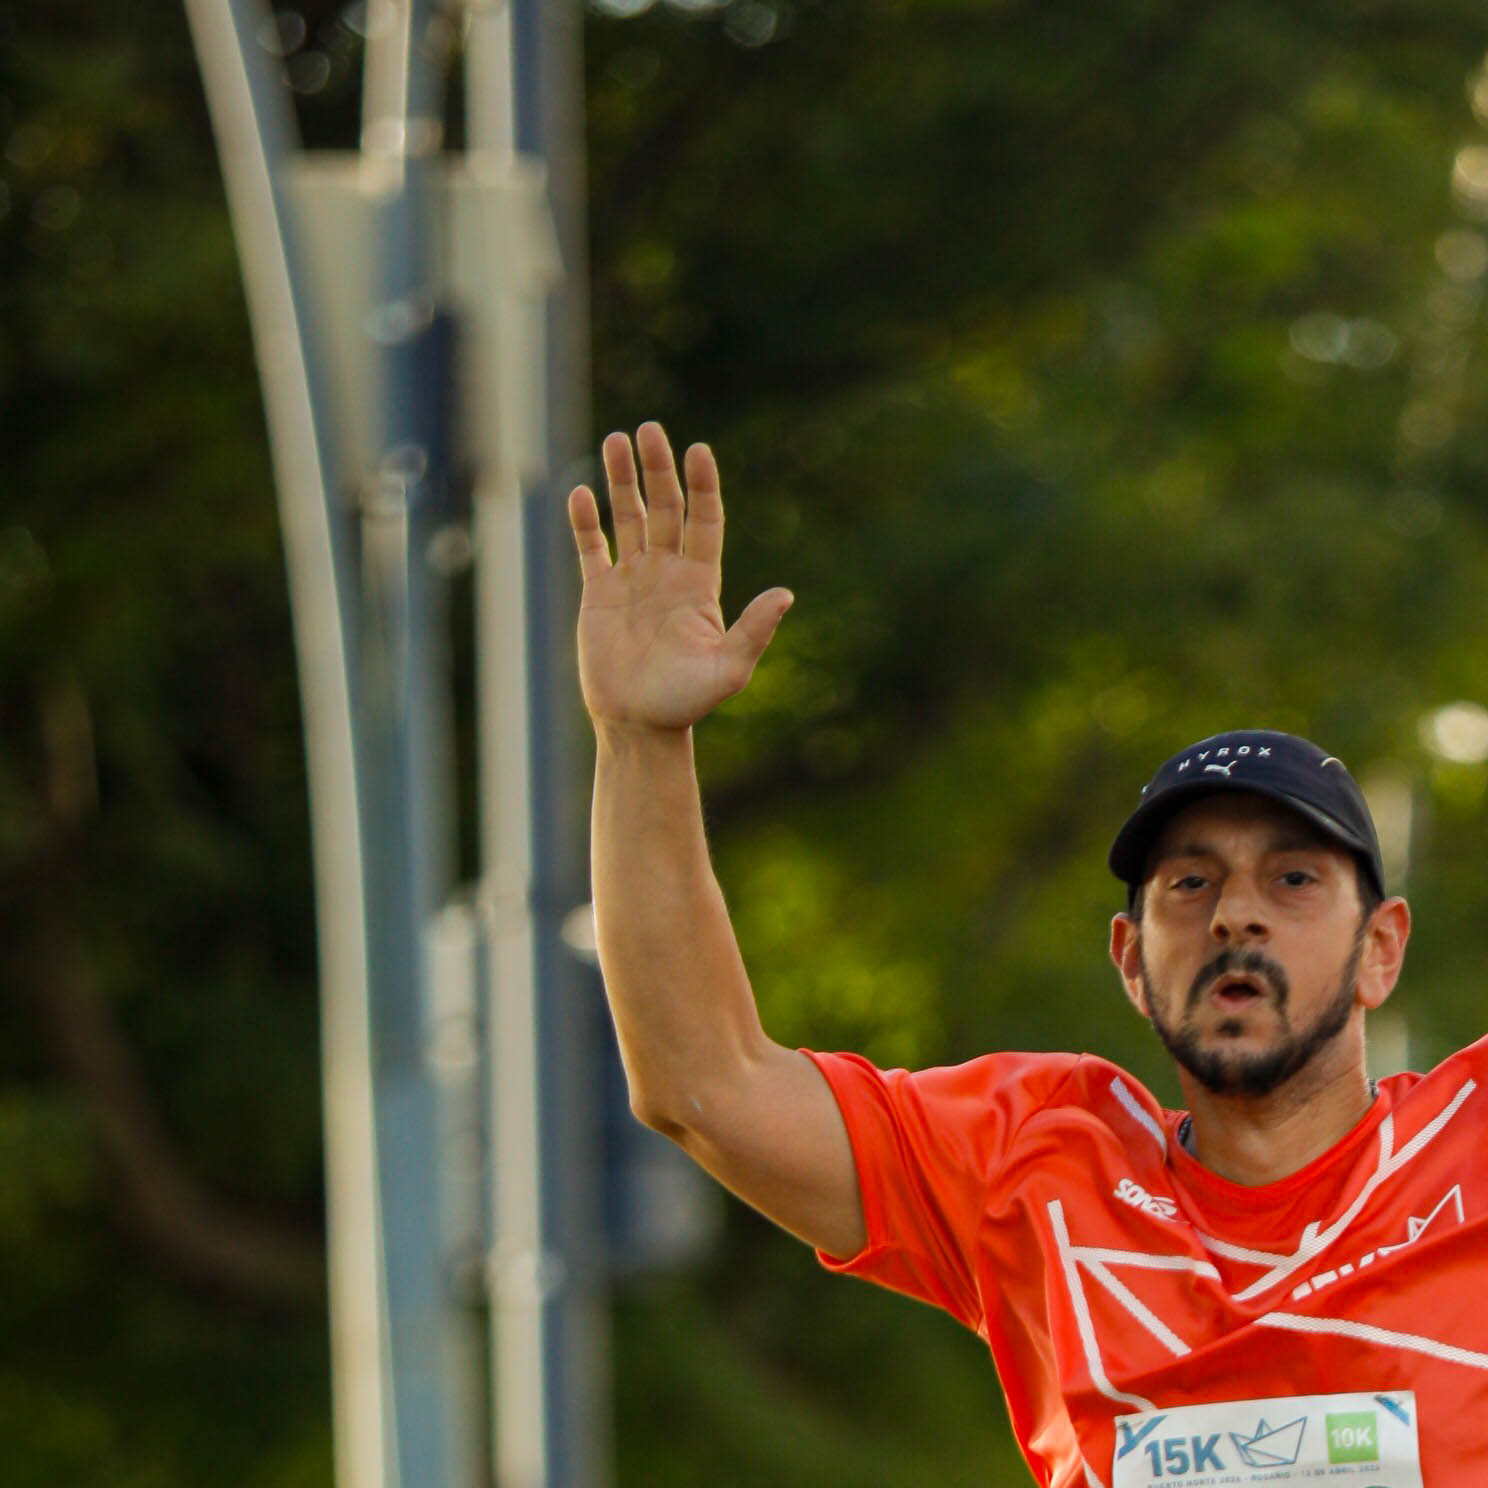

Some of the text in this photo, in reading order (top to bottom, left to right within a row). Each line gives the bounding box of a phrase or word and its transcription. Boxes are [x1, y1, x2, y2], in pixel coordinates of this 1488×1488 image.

[1178, 745, 1271, 773] HYROX
[1330, 1426, 1374, 1450] 10K
[1144, 1432, 1226, 1478] 15K
